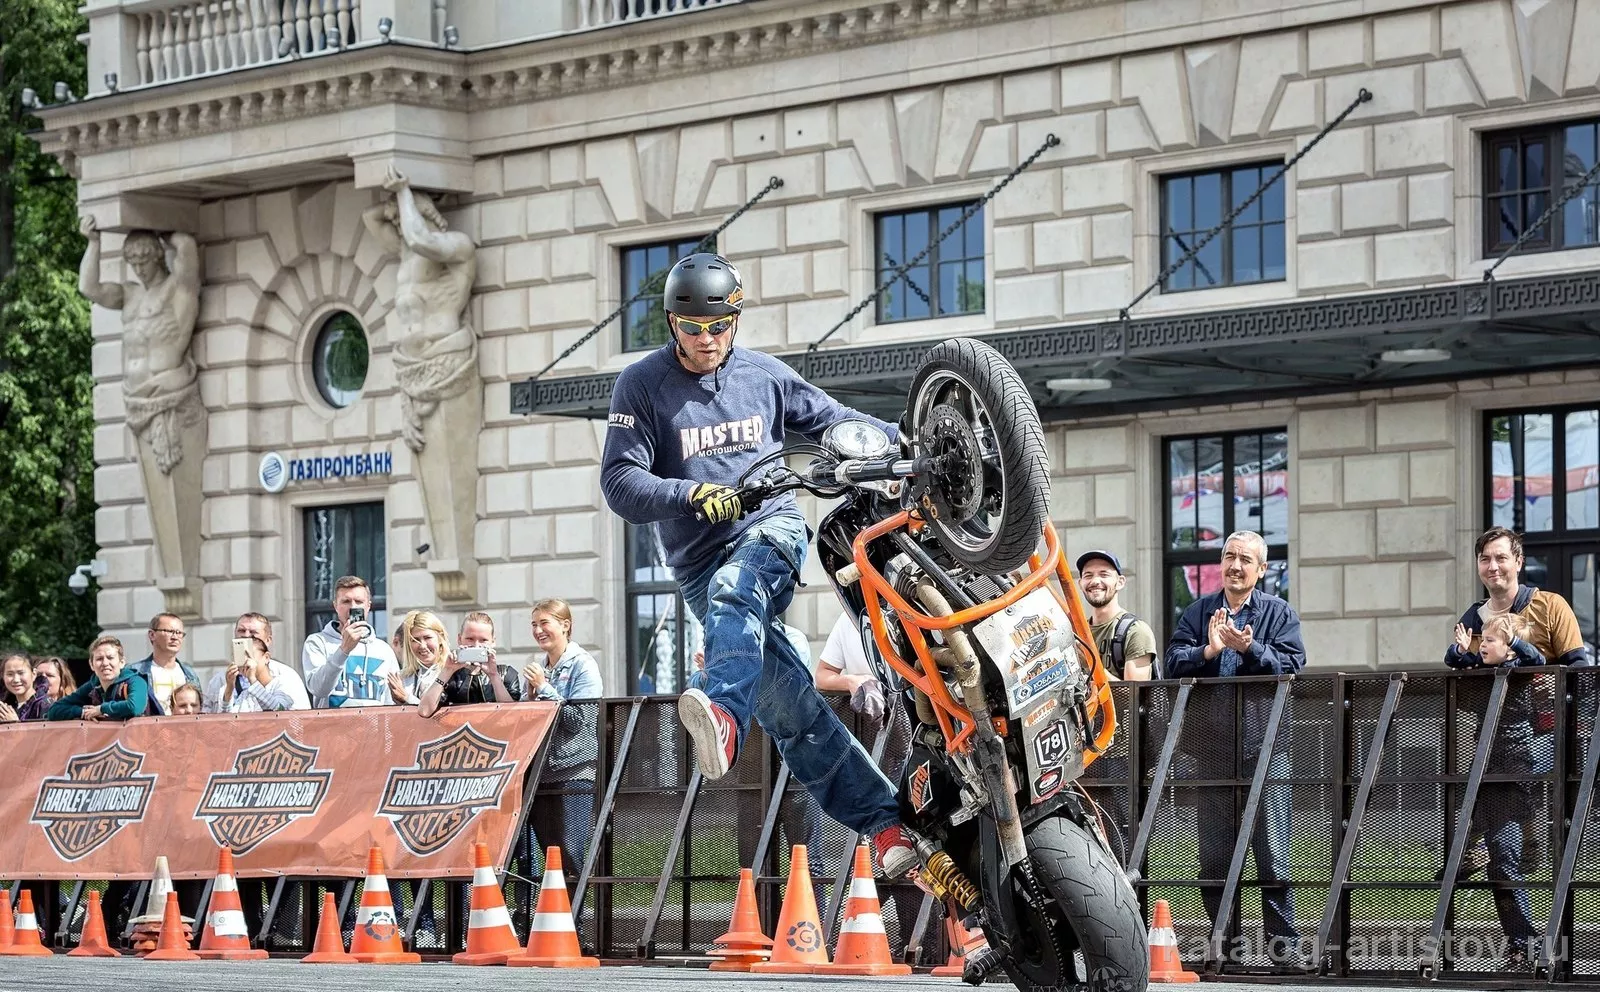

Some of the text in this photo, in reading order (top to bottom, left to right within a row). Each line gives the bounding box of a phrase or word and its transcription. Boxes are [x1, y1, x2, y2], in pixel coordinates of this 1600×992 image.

[680, 415, 764, 460] MASTER
[698, 443, 756, 459] МОТОШКОЛА
[288, 452, 392, 480] ГАЗПРОМБАНК
[427, 740, 490, 770] MOTOR
[1041, 733, 1061, 755] 78
[78, 755, 129, 781] MOTOR
[245, 746, 303, 774] MOTOR
[42, 786, 145, 813] HARLEY-DAVIDSON
[208, 781, 319, 808] HARLEY-DAVIDSON
[390, 774, 503, 806] HARLEY-DAVIDSON
[58, 819, 109, 851] CYCLES
[221, 815, 279, 845] CYCLES
[408, 808, 463, 844] CYCLES
